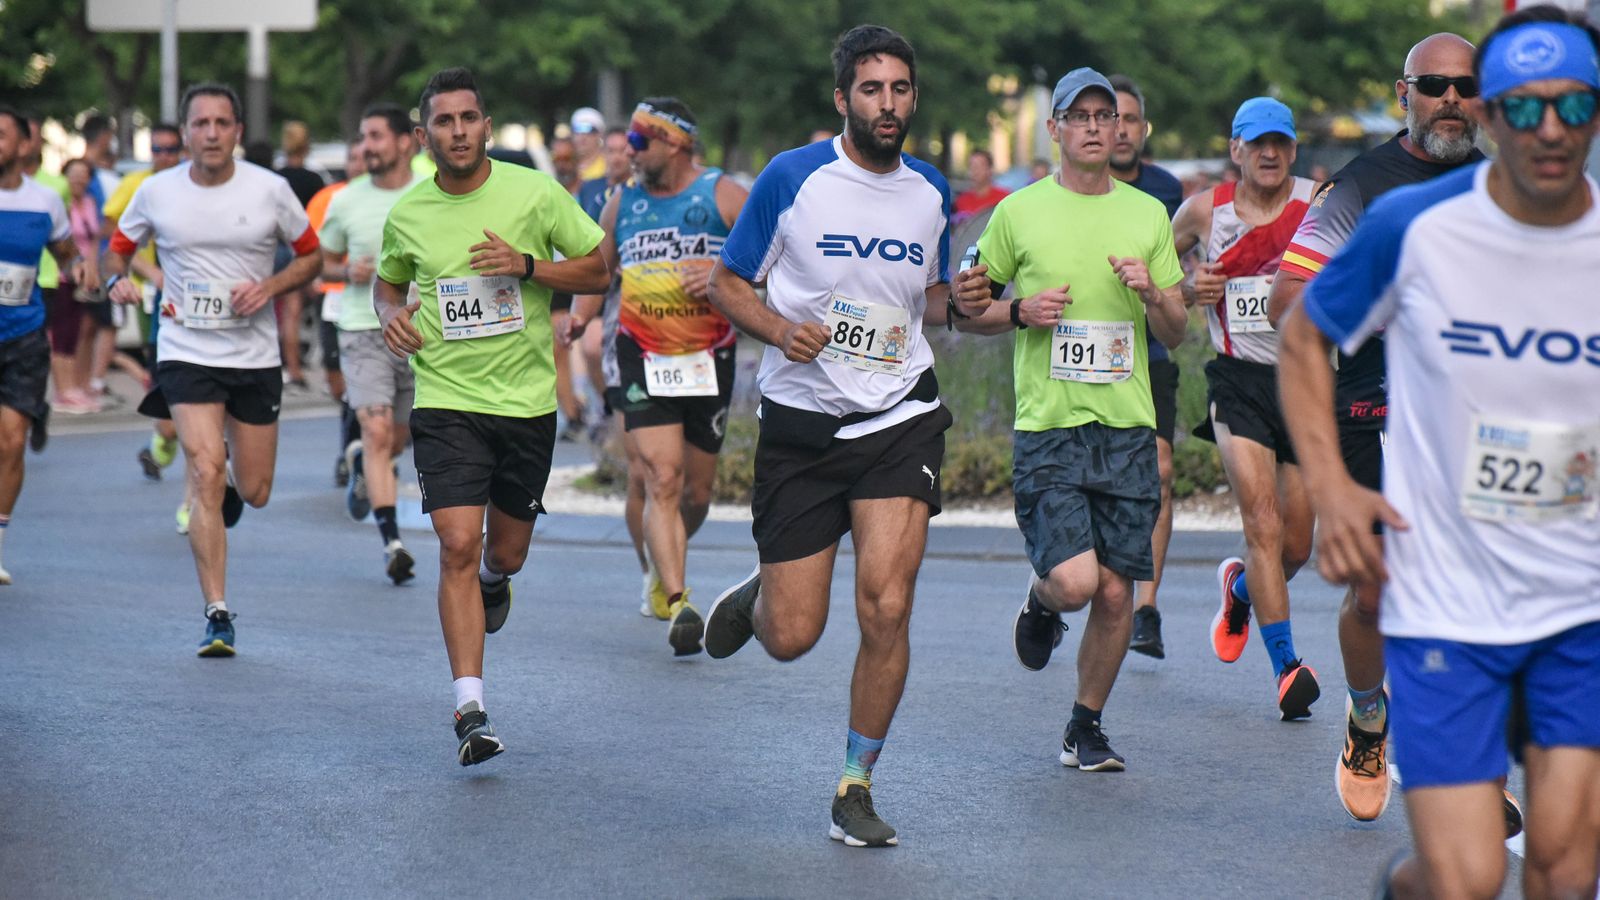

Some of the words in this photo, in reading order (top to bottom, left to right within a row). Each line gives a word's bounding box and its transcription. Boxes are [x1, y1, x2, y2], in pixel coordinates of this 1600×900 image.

[638, 231, 675, 248] TRAIL
[632, 247, 668, 262] TEAM
[816, 234, 924, 266] EVOS
[441, 283, 454, 294] XXI
[193, 296, 222, 314] 779
[446, 297, 483, 322] 644
[833, 300, 851, 314] XXI
[833, 321, 876, 351] 861
[1057, 324, 1072, 334] XXI
[1059, 341, 1095, 365] 191
[653, 369, 683, 385] 186
[1478, 454, 1543, 495] 522
